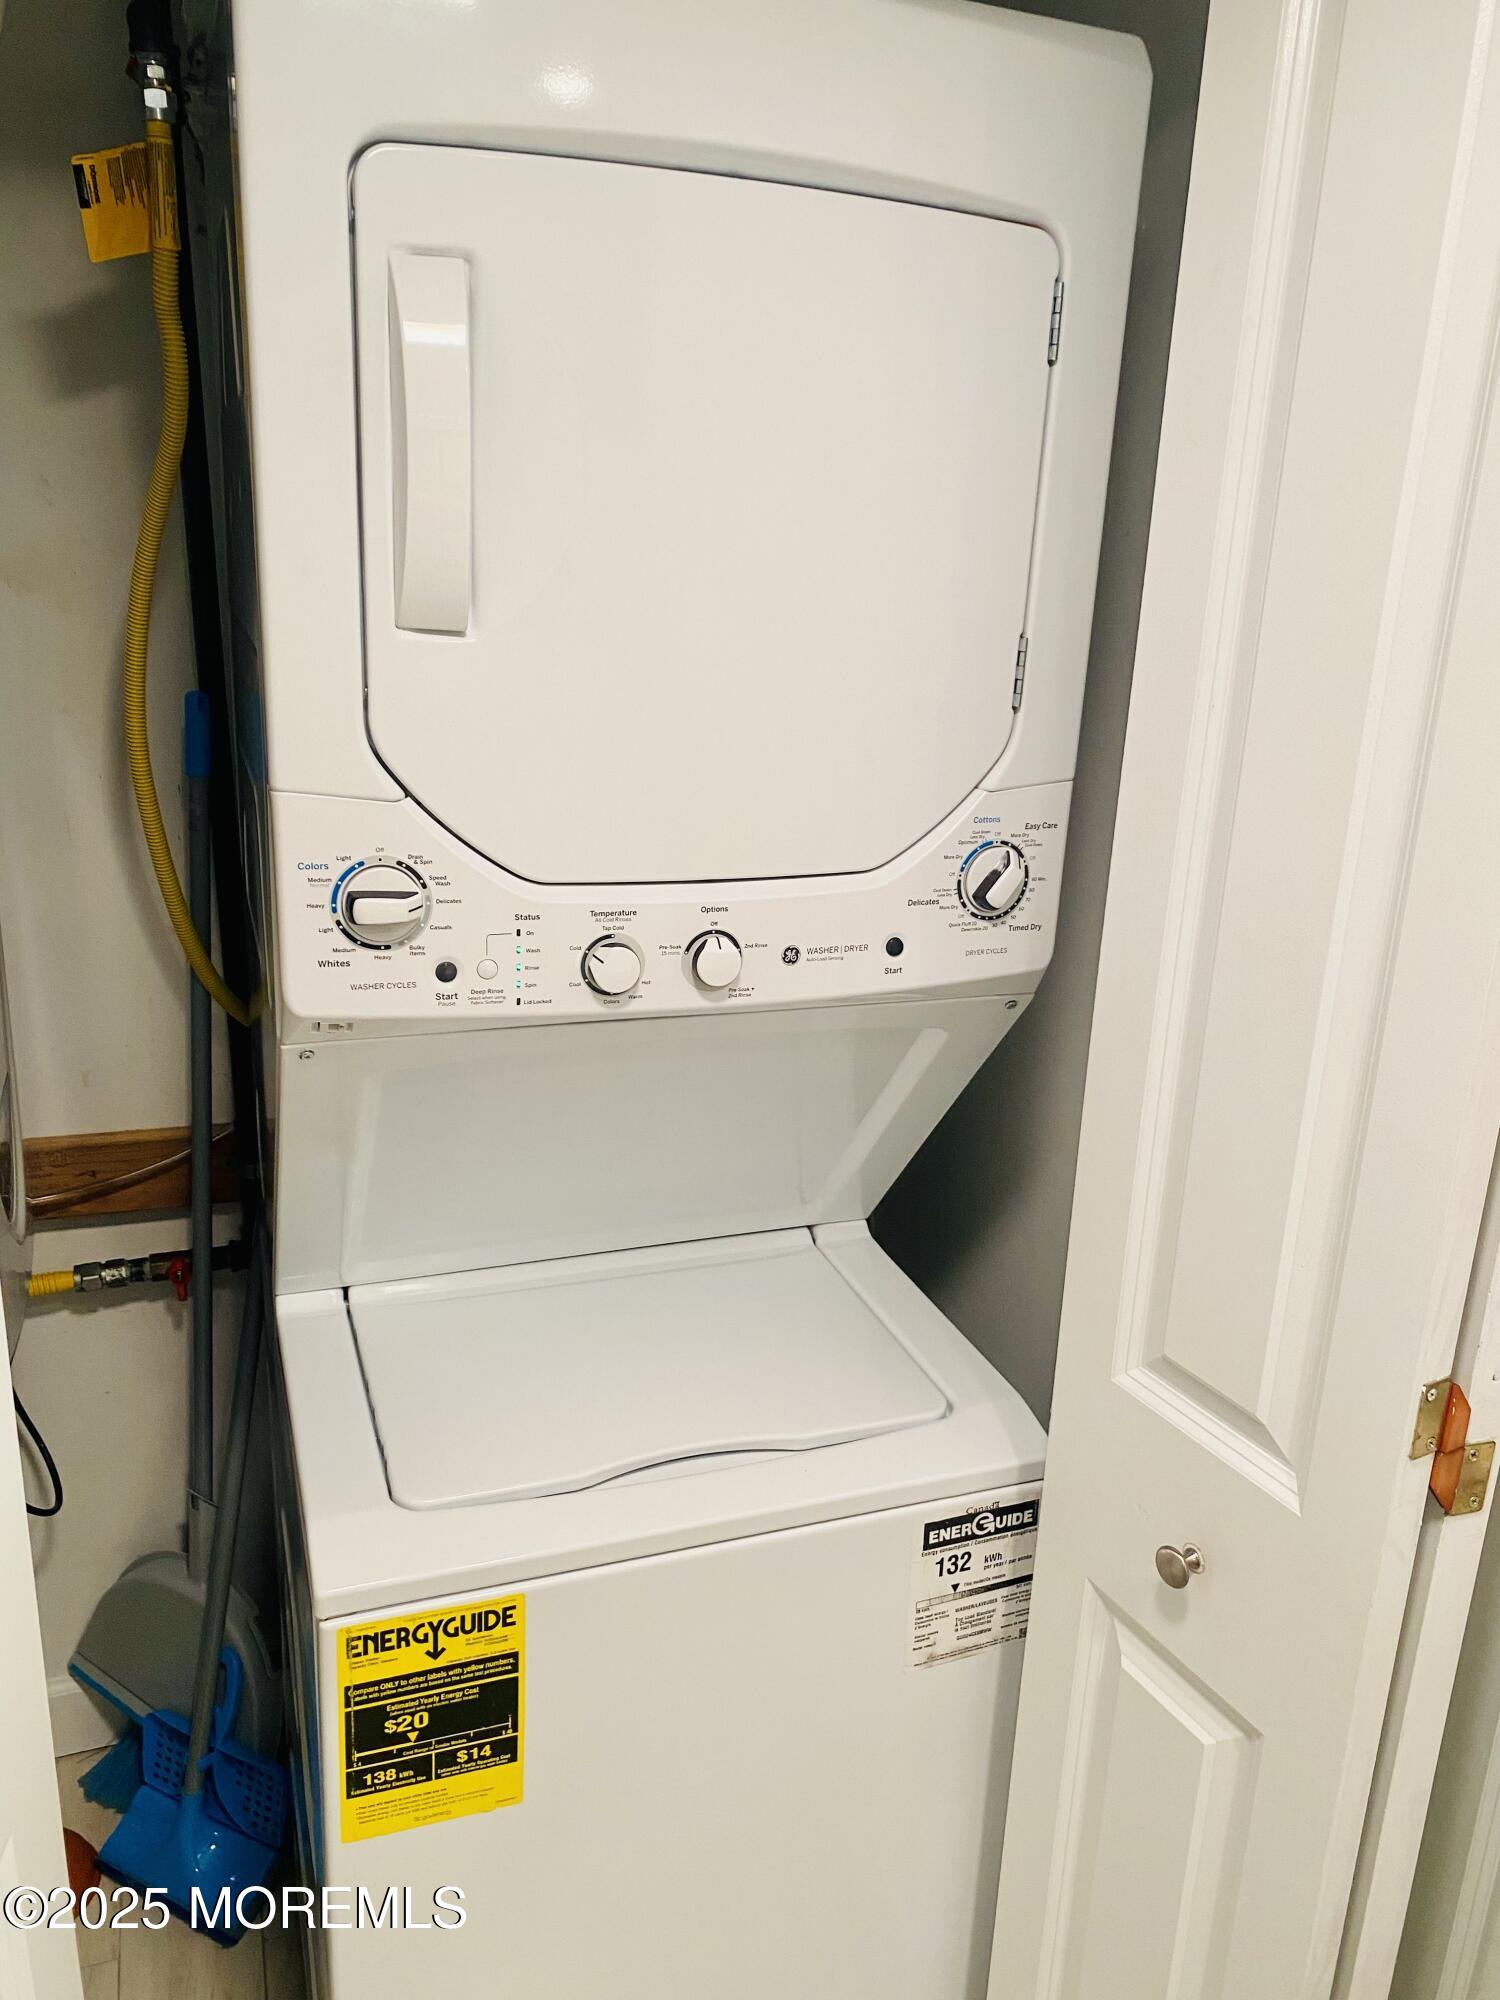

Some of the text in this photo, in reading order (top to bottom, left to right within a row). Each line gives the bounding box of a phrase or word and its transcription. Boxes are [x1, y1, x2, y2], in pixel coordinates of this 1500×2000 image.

[973, 816, 1001, 824] Cottons
[1025, 823, 1041, 831] Easy
[297, 862, 329, 870] Colors
[907, 898, 940, 906] Delicates
[590, 909, 637, 918] Temperature
[701, 905, 728, 914] Options
[514, 913, 541, 921] Status
[1008, 924, 1029, 932] Timed
[806, 944, 869, 955] WASHER DRYER
[318, 959, 350, 968] Whites
[350, 981, 417, 991] WASHER CYCLES
[435, 992, 458, 1001] Start
[929, 1509, 1033, 1544] ENERGUIDE
[921, 1550, 938, 1558] Energy
[939, 1542, 970, 1554] consumption
[974, 1533, 1008, 1546] Consommation
[935, 1551, 1003, 1578] 132 kWh
[993, 1561, 1004, 1569] year
[346, 1605, 517, 1660] ENERGYGUIDE
[348, 1657, 516, 1697] Compare ONLY to other labels with yellow numbers.
[386, 1686, 480, 1712] Estimated Yearly Energy Cost
[384, 1711, 430, 1734] $20
[456, 1744, 492, 1763] $14
[363, 1768, 396, 1786] 138
